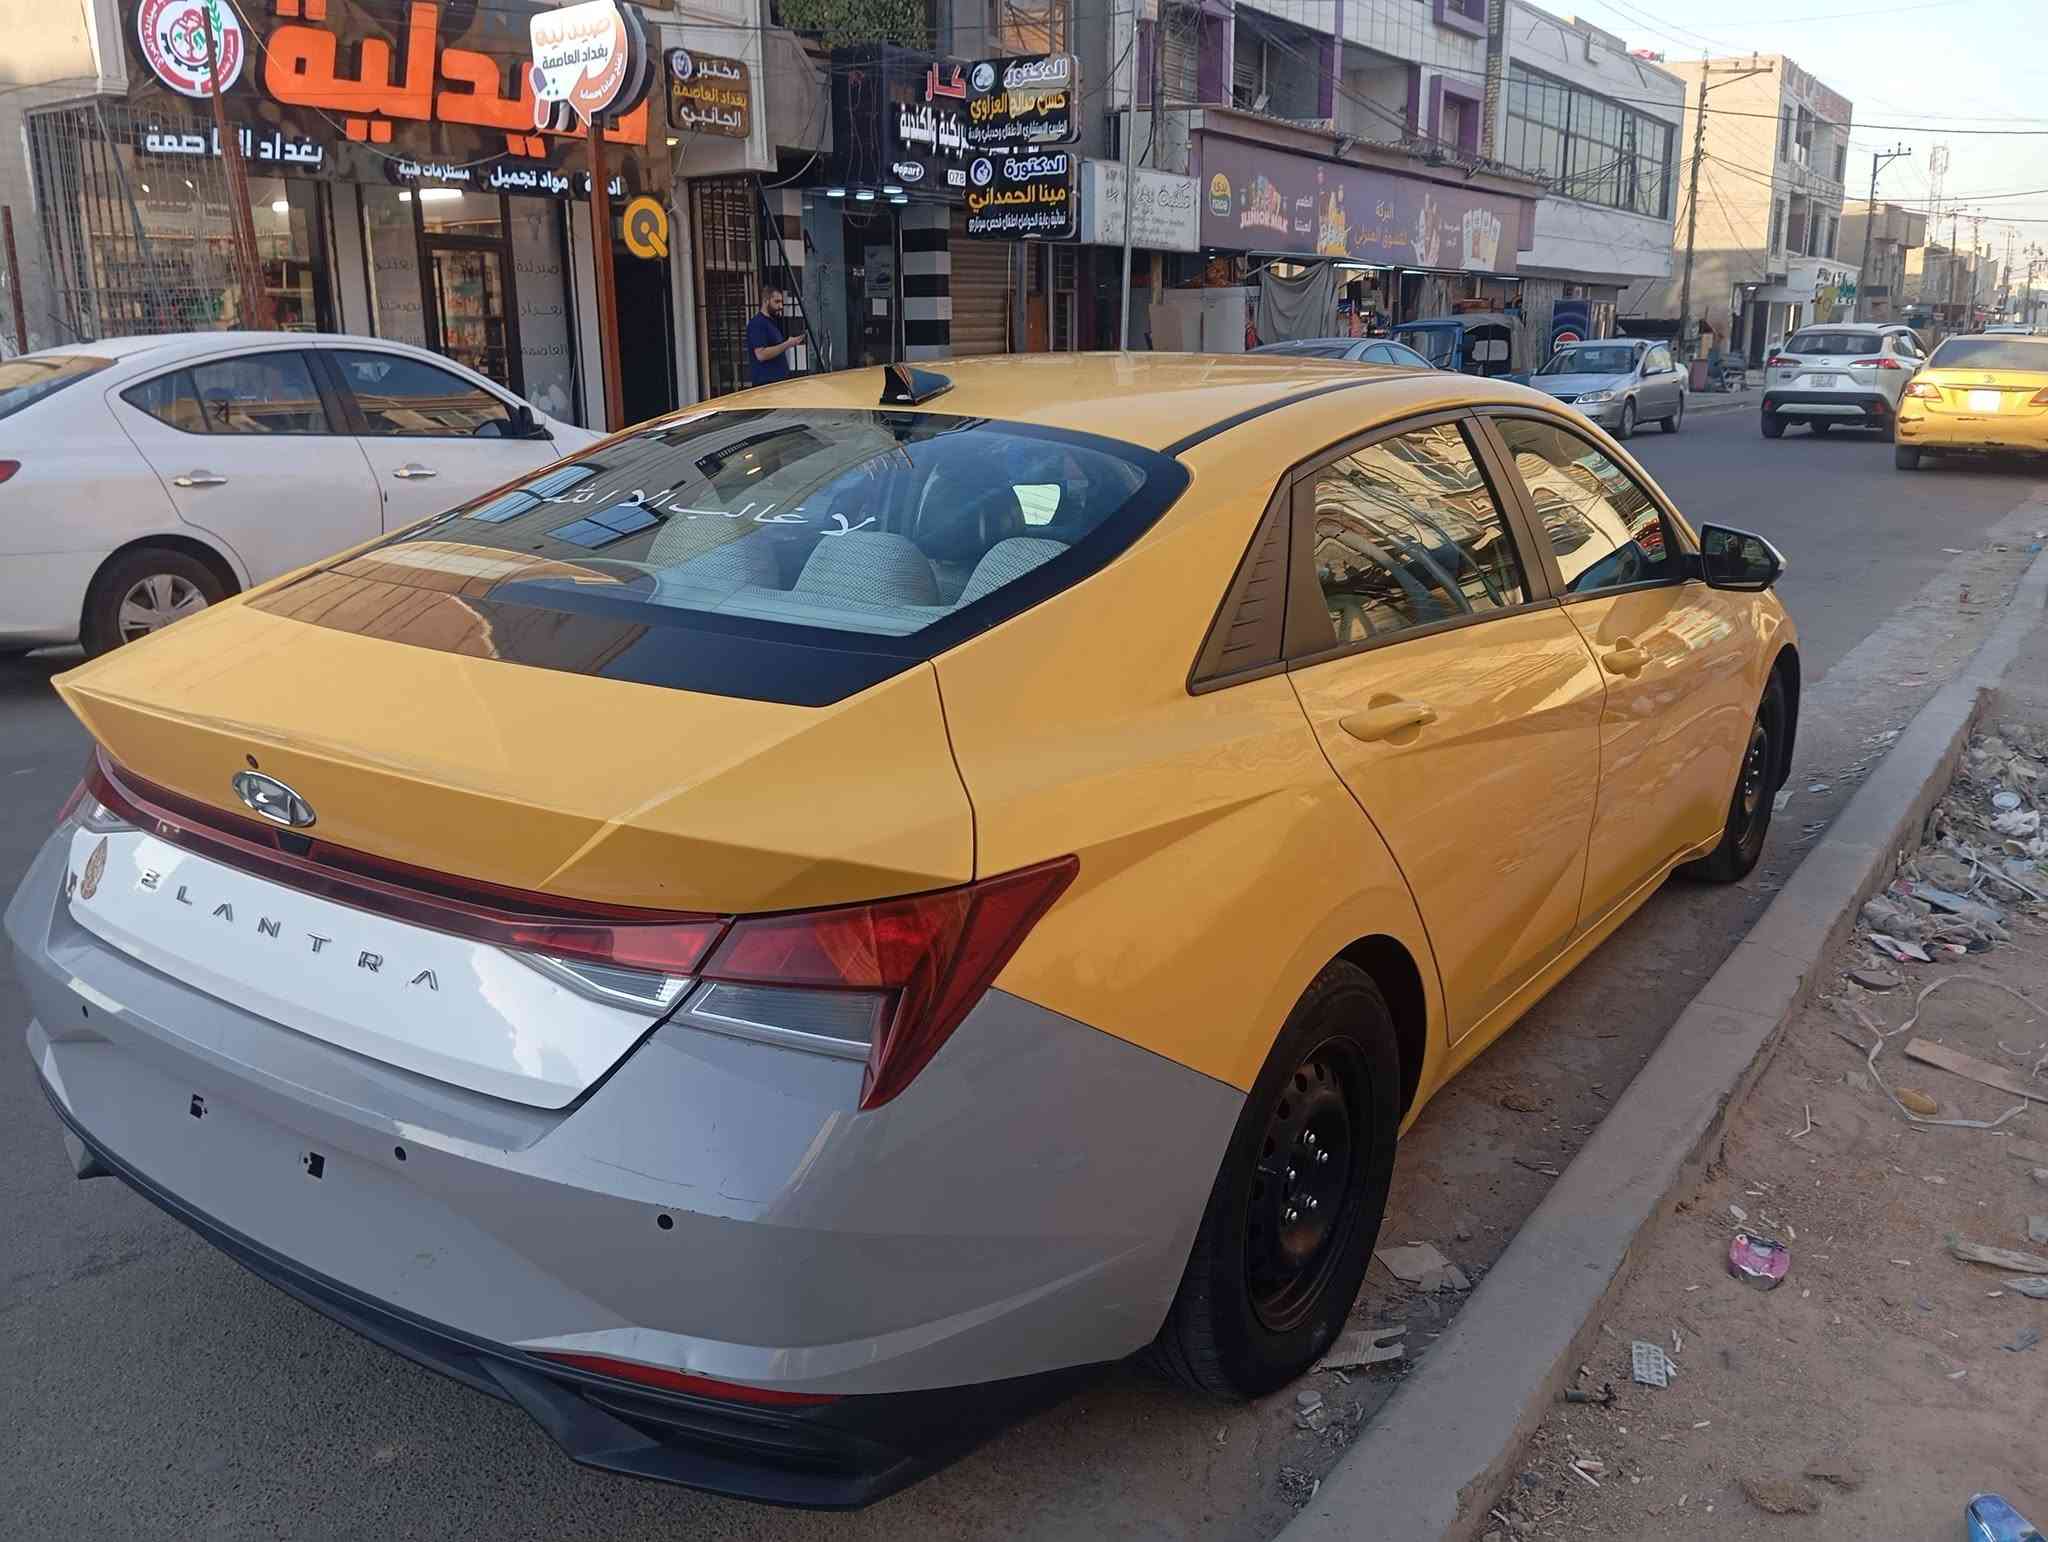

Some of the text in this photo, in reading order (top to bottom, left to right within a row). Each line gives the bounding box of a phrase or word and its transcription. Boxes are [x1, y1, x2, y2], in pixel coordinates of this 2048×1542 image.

[542, 44, 608, 69] بغداد العاصمة
[697, 61, 740, 80] مختبر
[1003, 59, 1068, 88] الدكتور
[673, 81, 719, 103] العاصمة
[146, 126, 323, 170] بغداد الاصمة
[423, 162, 470, 182] مستلزمات
[490, 165, 569, 193] مواد تجميل
[1003, 154, 1067, 181] الدكتورة
[968, 184, 1066, 213] مينا الحمداني
[623, 197, 668, 258] Q
[138, 867, 441, 993] ELANTRA
